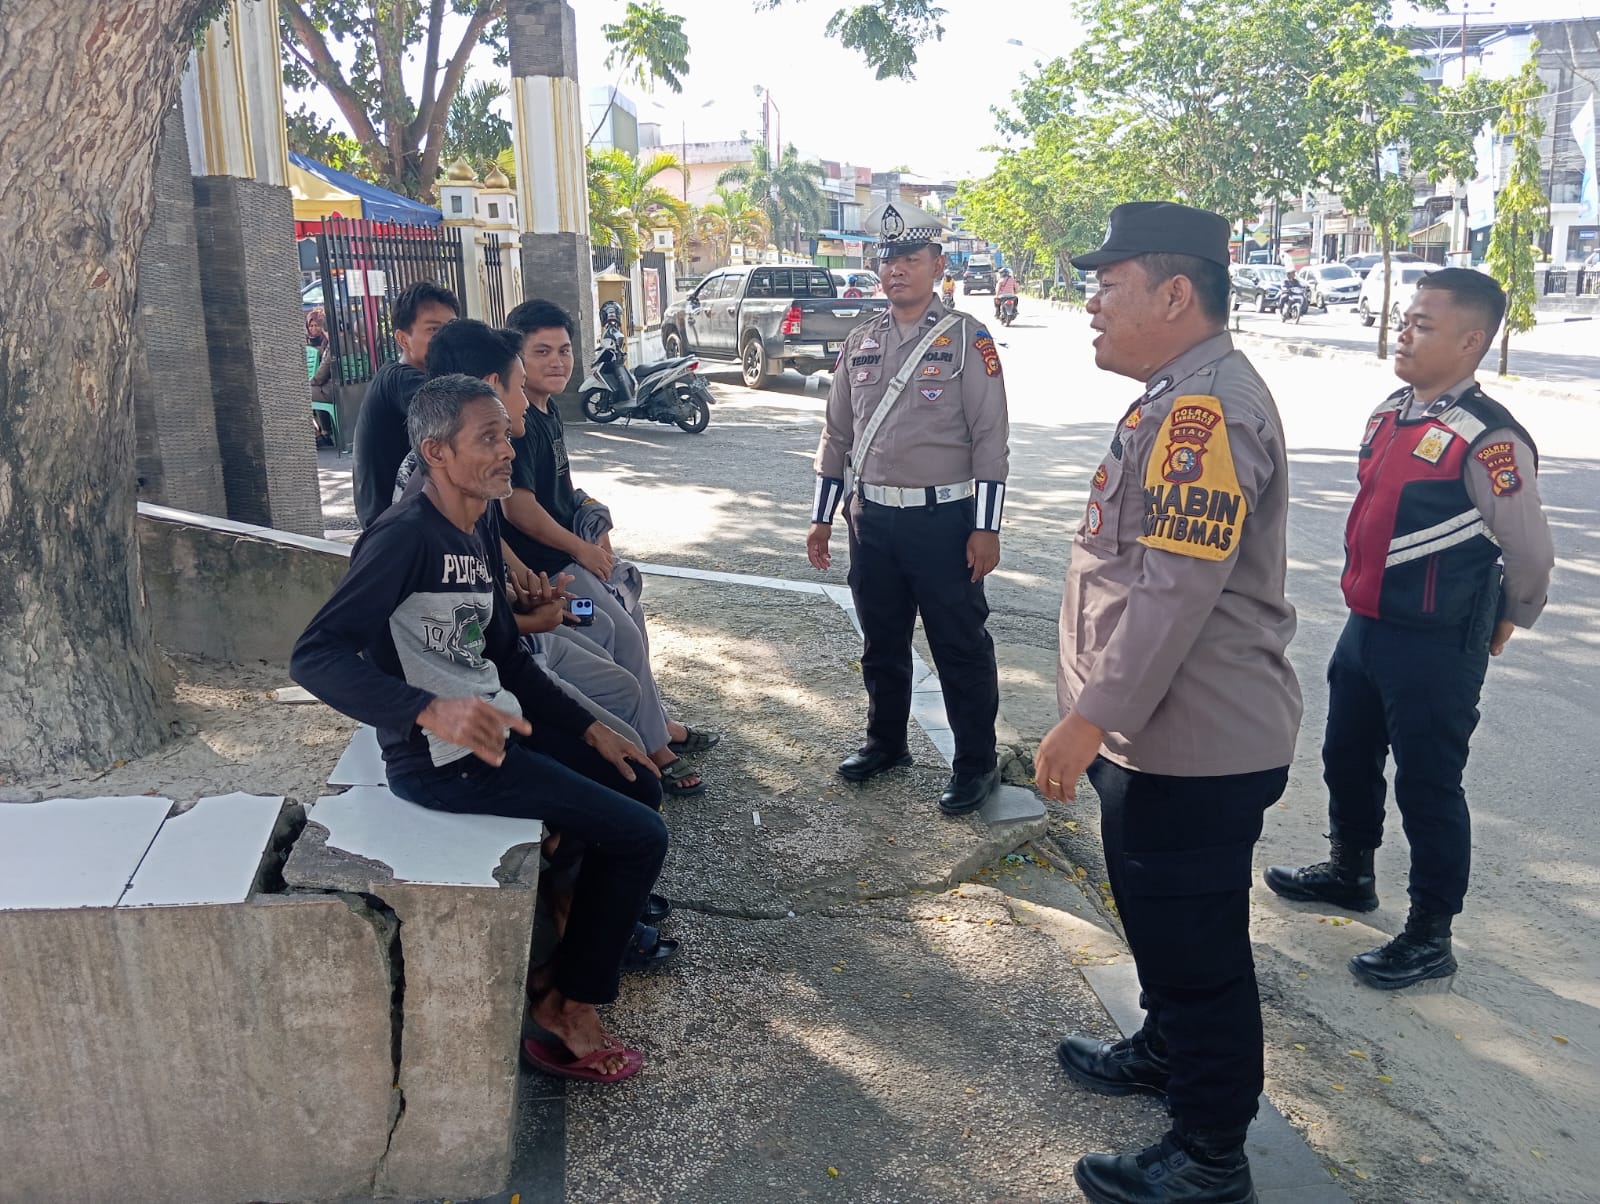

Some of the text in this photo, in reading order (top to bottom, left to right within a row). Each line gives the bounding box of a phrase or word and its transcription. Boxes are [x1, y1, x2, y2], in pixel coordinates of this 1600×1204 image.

[851, 354, 882, 367] TEDDY
[1174, 408, 1216, 422] POLRES
[1173, 428, 1206, 438] RIAU
[1478, 444, 1511, 459] POLRES
[1487, 456, 1512, 468] RIAU
[1143, 485, 1241, 526] HABIN
